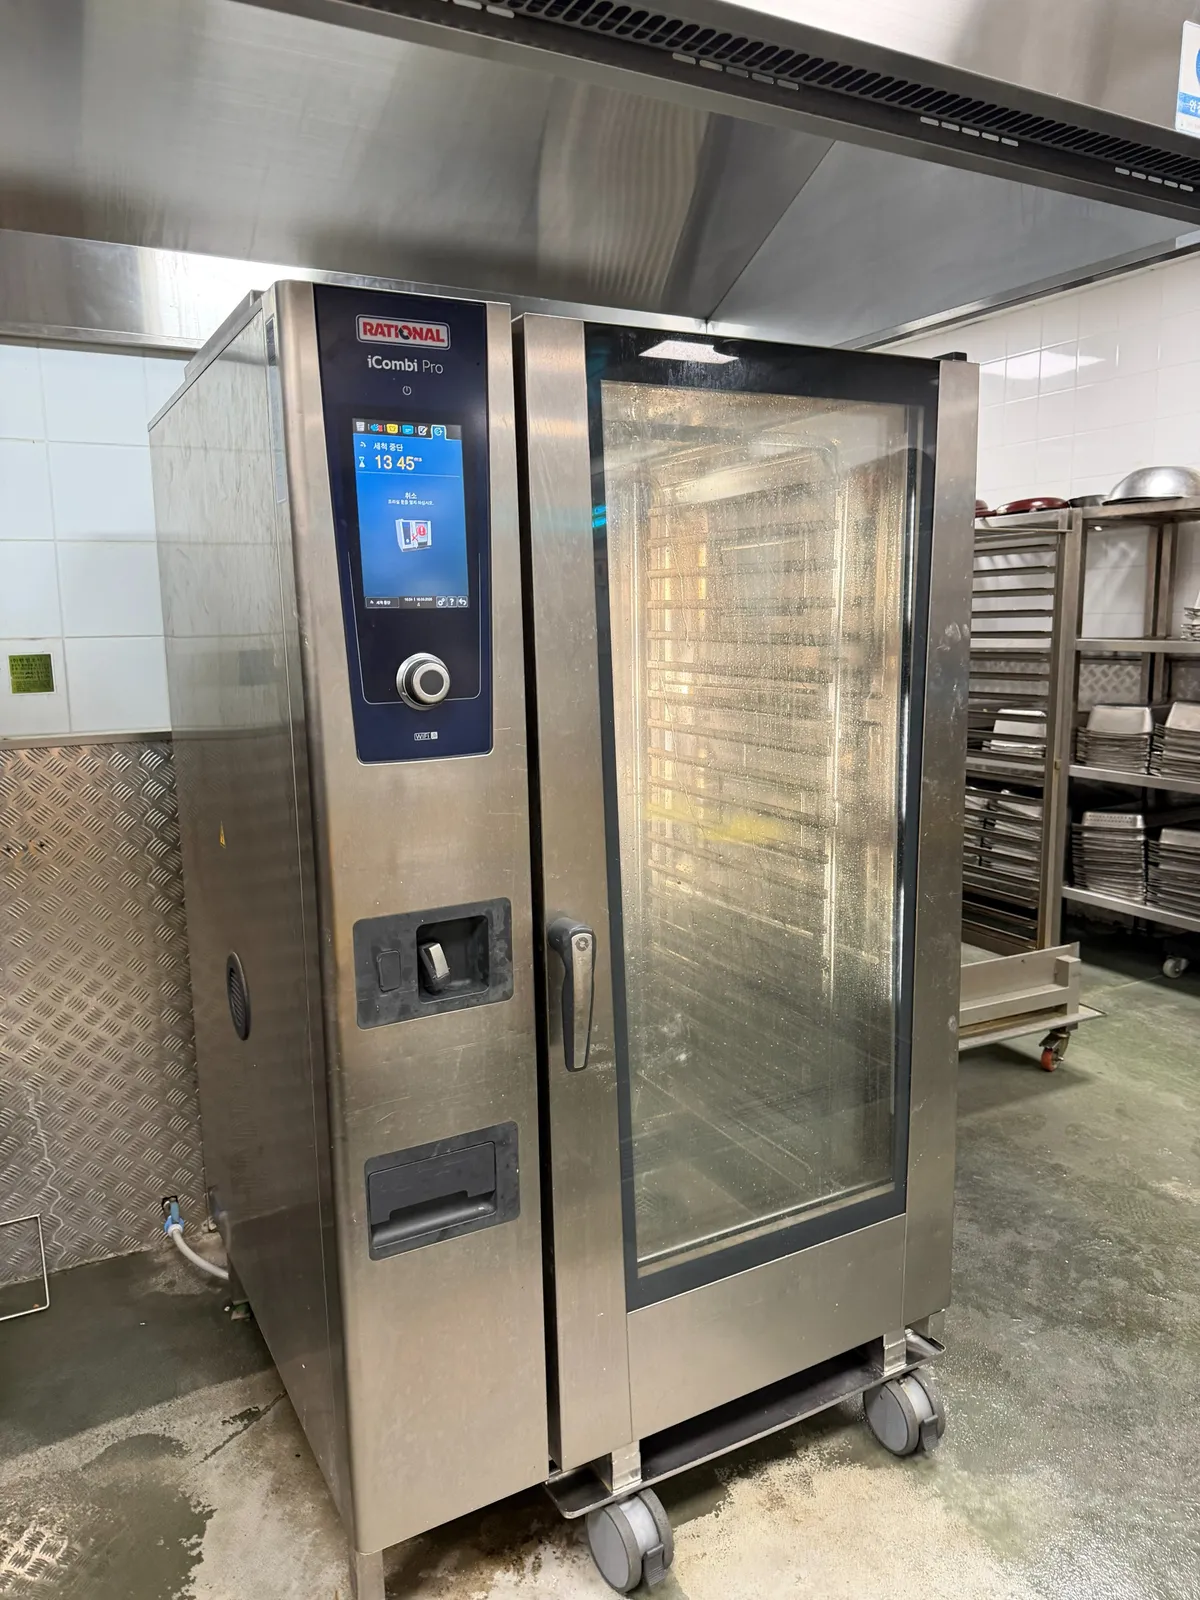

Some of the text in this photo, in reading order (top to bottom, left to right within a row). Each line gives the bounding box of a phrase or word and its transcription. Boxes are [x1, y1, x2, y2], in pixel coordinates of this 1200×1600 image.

[362, 321, 446, 343] RATIONAL
[367, 355, 444, 374] iCombi Pro
[389, 442, 403, 452] 중단
[375, 454, 393, 470] 13
[396, 455, 415, 471] 45
